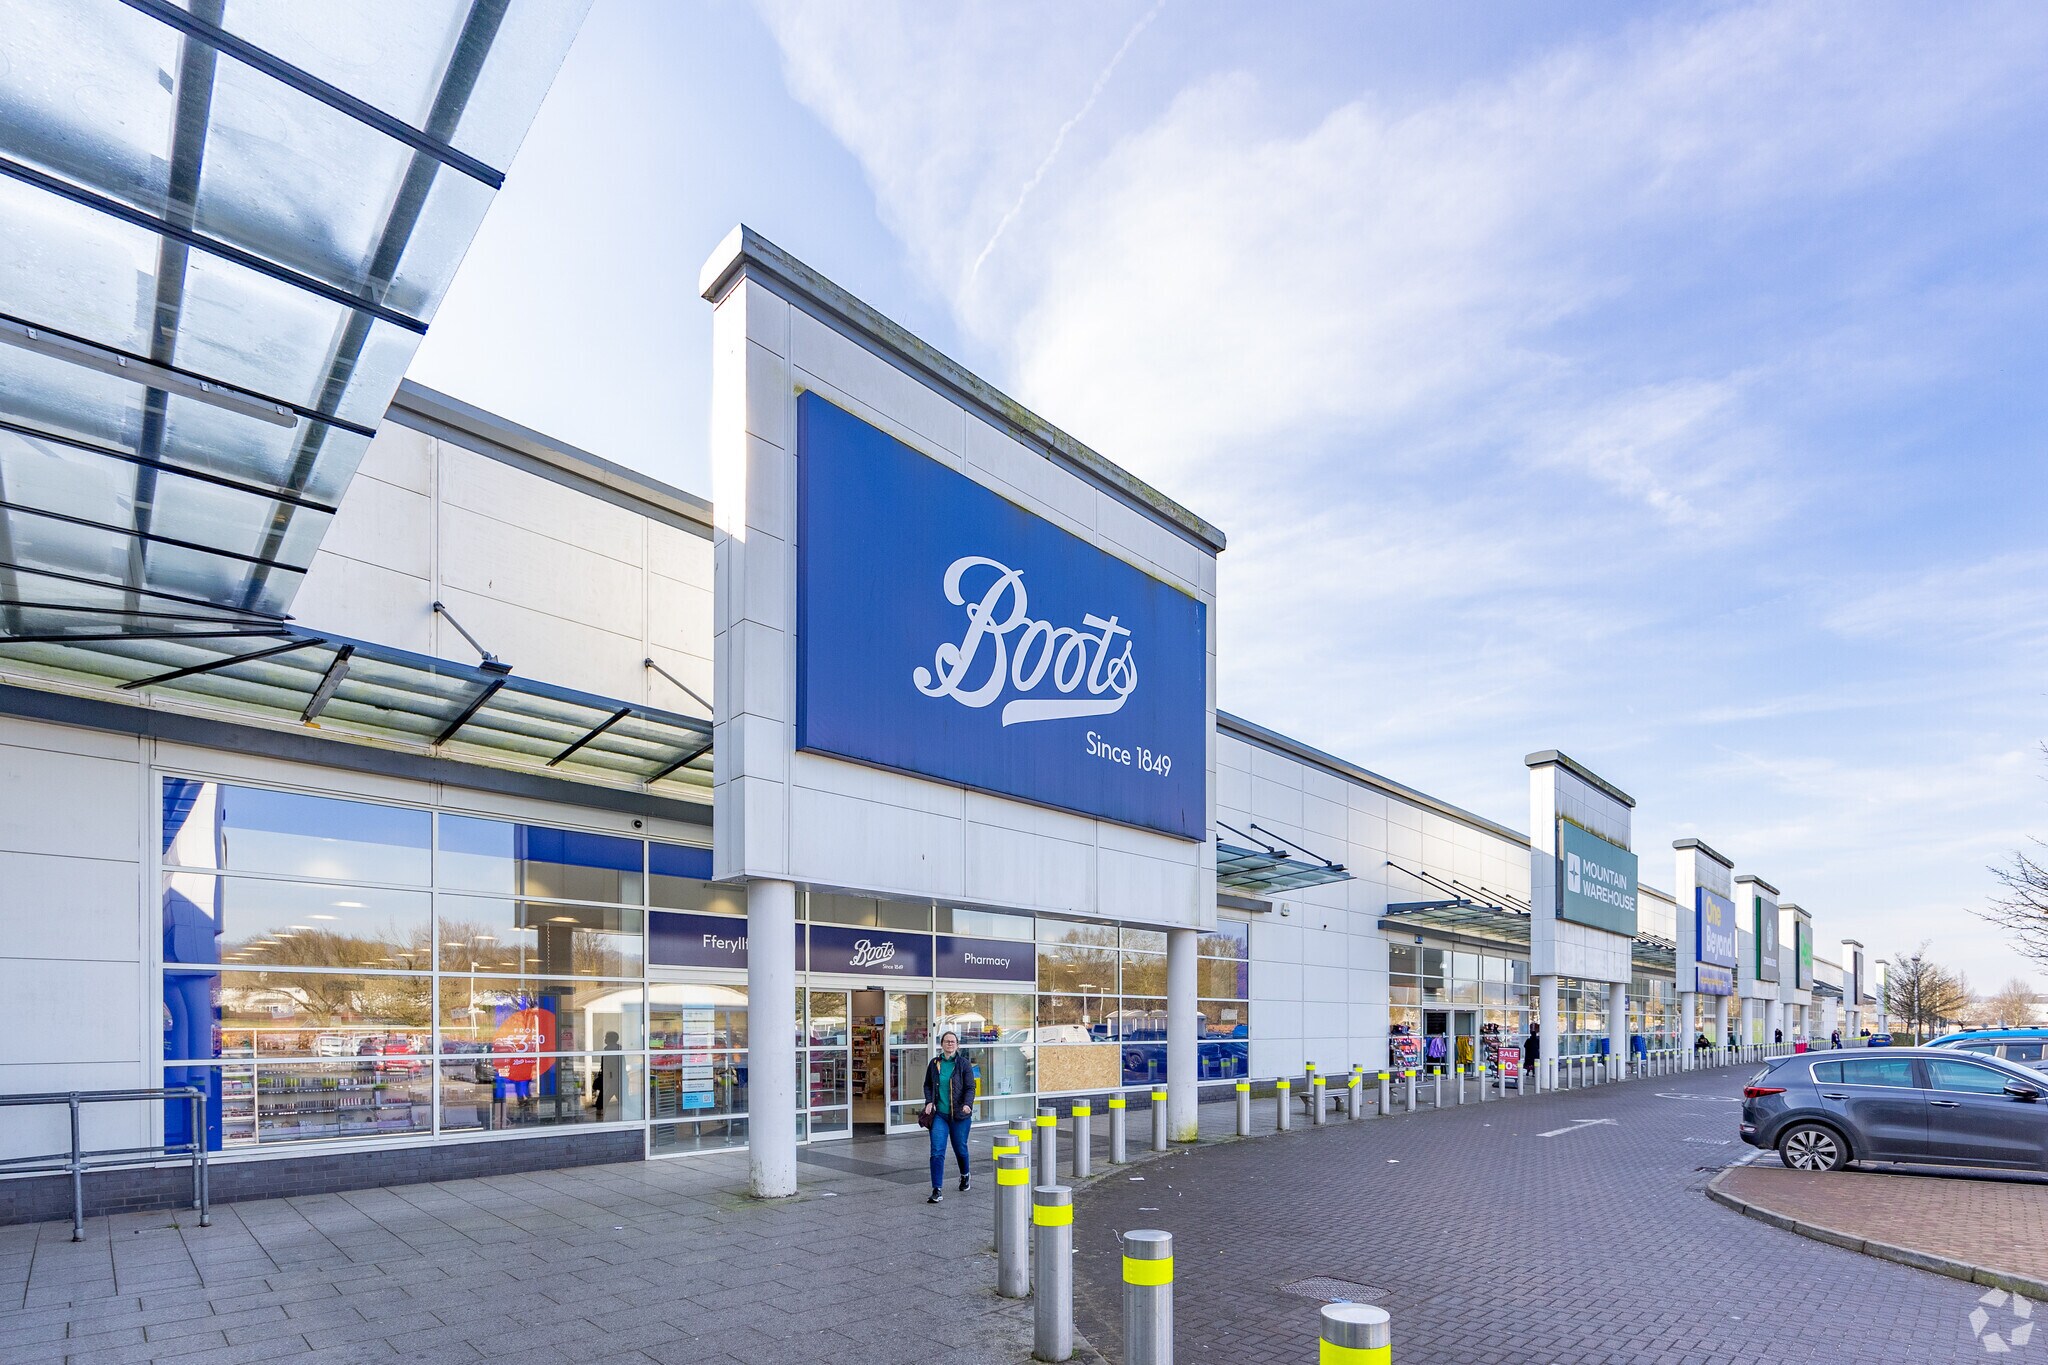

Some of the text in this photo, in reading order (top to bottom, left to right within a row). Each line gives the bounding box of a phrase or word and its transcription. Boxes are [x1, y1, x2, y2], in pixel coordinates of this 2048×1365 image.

[912, 555, 1138, 728] Boots
[1086, 731, 1172, 778] Since 1849
[1582, 859, 1627, 890] MOUNTAIN
[1582, 879, 1635, 912] WAREHOUSE
[1706, 895, 1721, 927] One
[849, 939, 895, 967] Boots
[1706, 924, 1732, 961] Beyond
[964, 952, 1010, 969] Pharmacy
